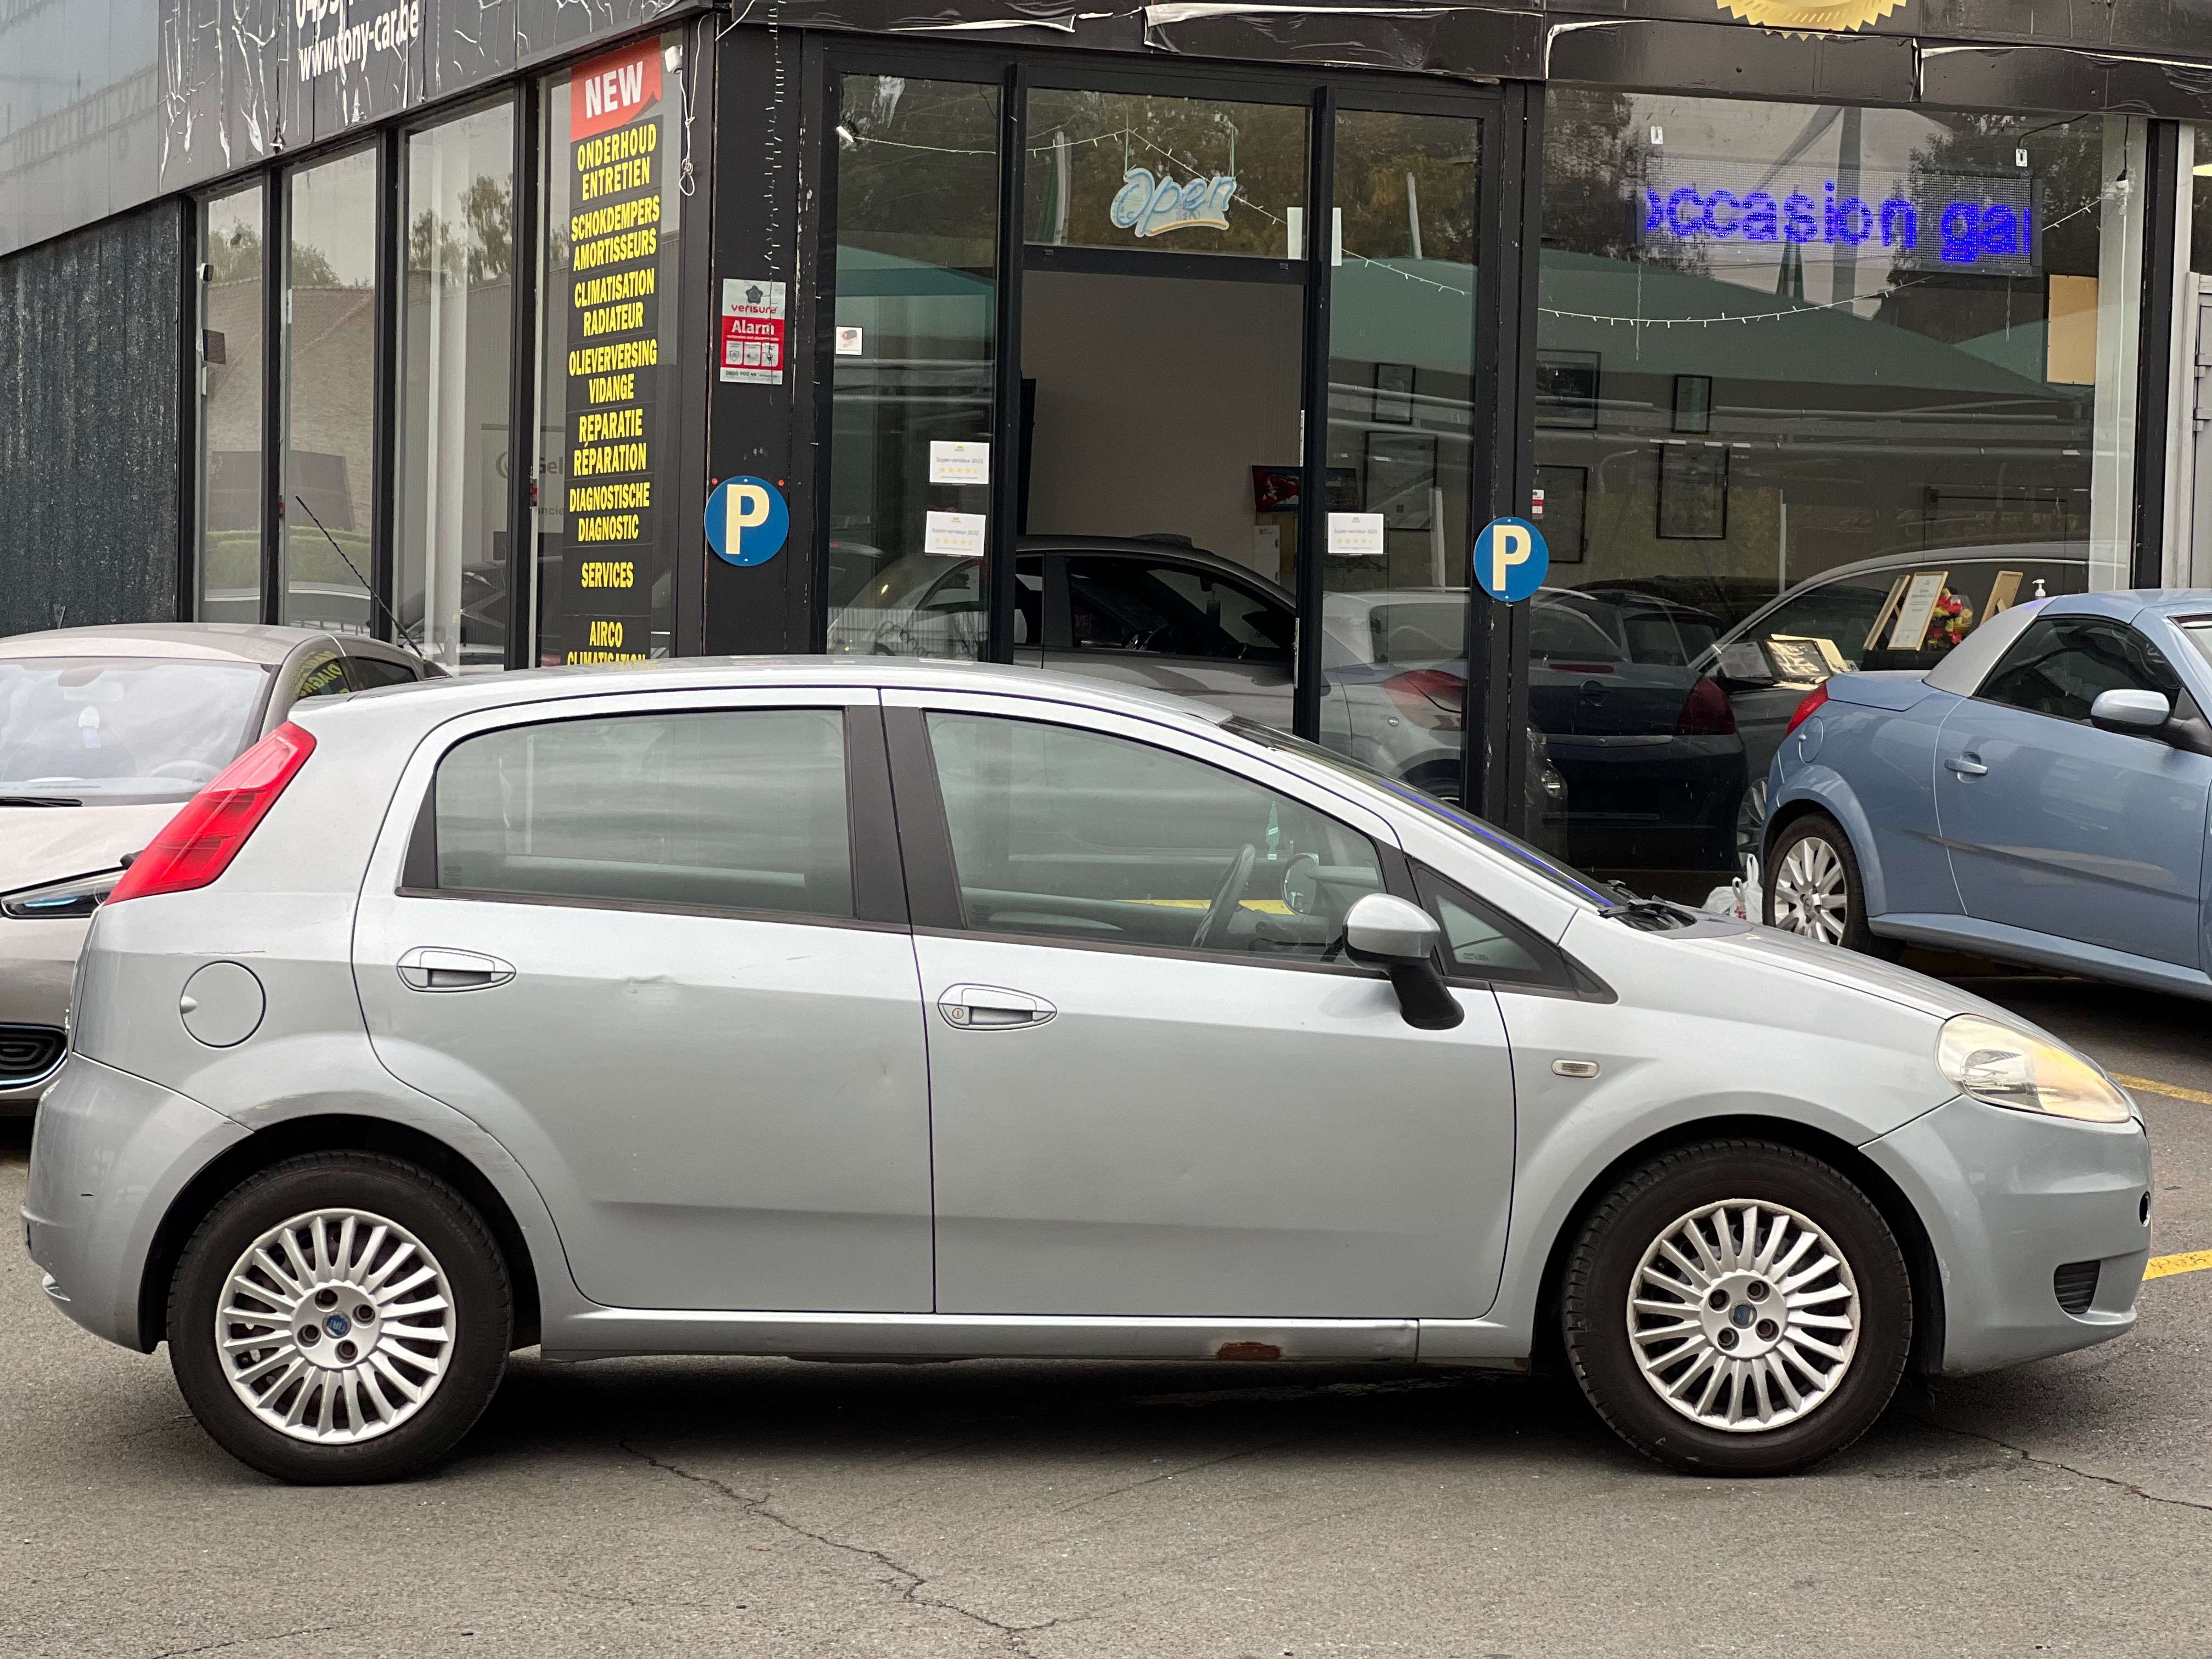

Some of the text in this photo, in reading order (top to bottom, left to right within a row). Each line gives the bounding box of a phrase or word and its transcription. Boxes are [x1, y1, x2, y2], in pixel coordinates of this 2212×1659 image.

[300, 1, 419, 82] www.tony-car.be
[585, 61, 643, 119] NEW
[577, 123, 657, 172] ONDERHOUD
[582, 156, 650, 201] ENTRETIEN
[571, 195, 660, 242] SCHOKDEMPERS
[1113, 170, 1236, 235] Open
[573, 228, 657, 272] AMORTISSEURS
[574, 268, 655, 308] CLIMATISATION
[583, 302, 644, 337] RADIATEUR
[731, 304, 777, 314] verisure
[731, 320, 775, 335] Alarm
[569, 338, 657, 376] OLIEVERVERSING
[589, 374, 635, 404] VIDANGE
[579, 408, 643, 443] REPARATIE
[574, 441, 647, 476] RÉPARATION
[569, 482, 650, 512] DIAGNOSTISCHE
[578, 514, 639, 541] DIAGNOSTIC
[726, 484, 770, 555] P
[581, 561, 634, 588] SERVICES
[1493, 525, 1531, 591] P
[589, 621, 623, 647] AIRCO
